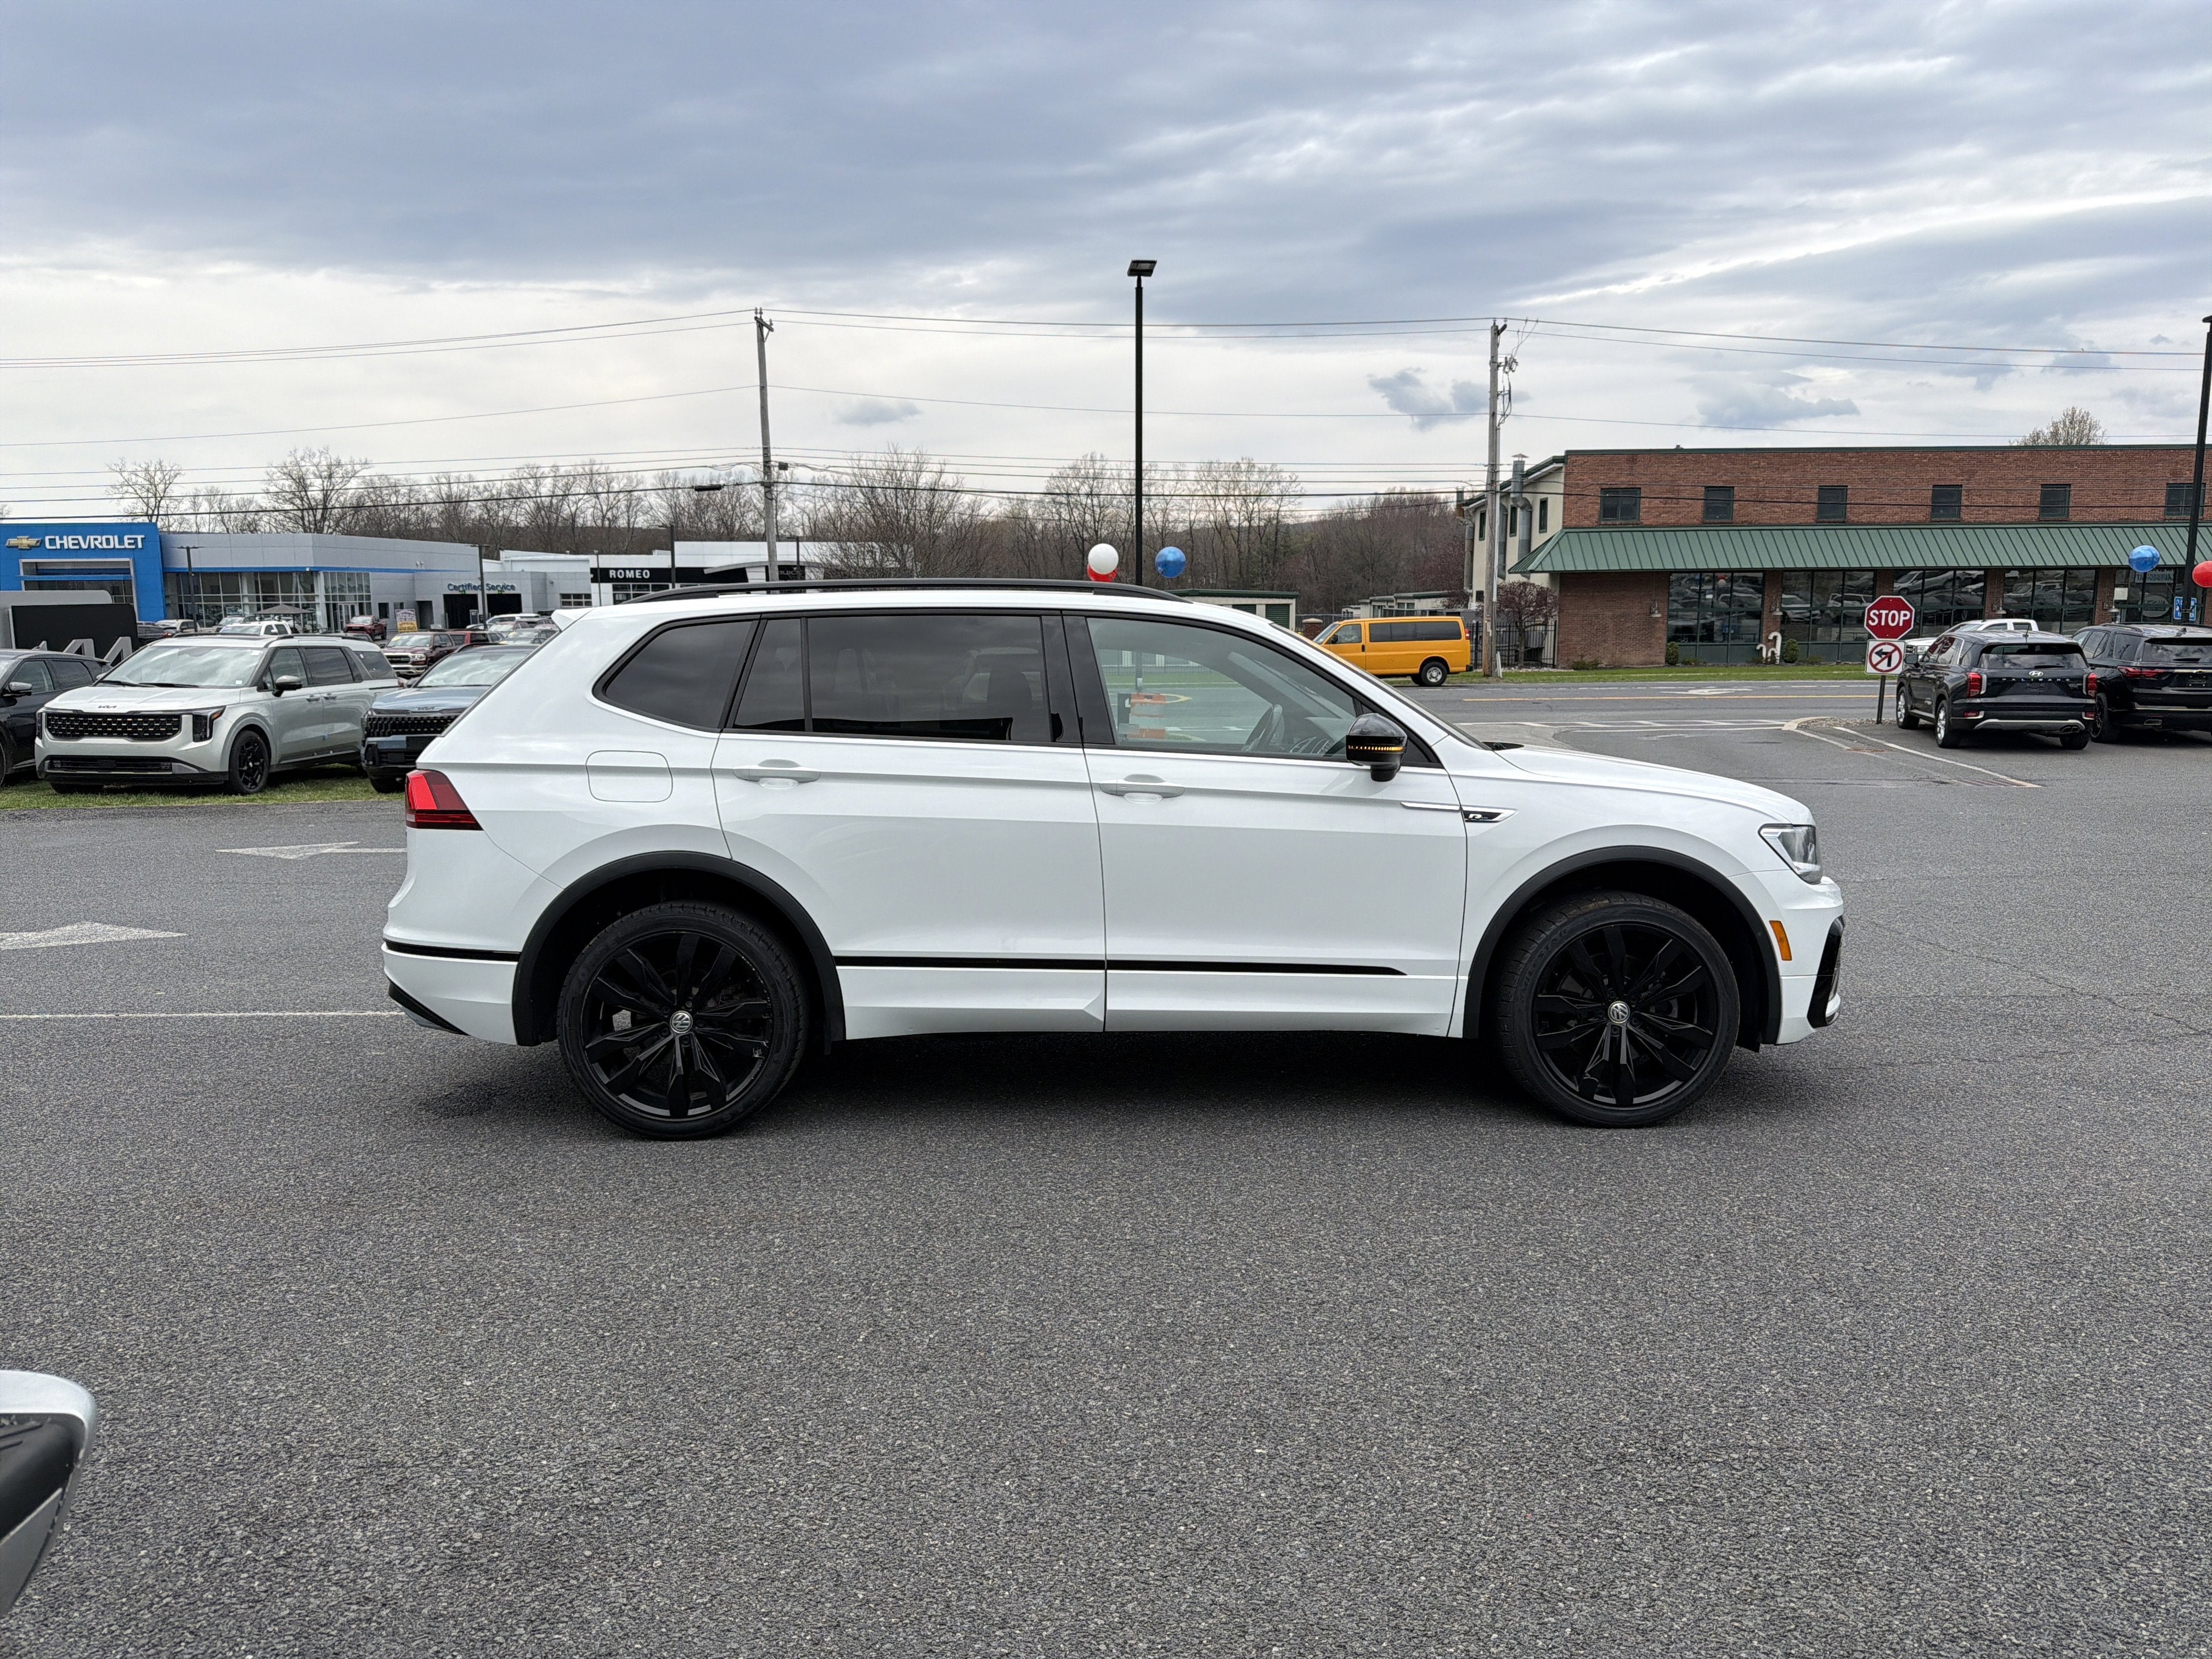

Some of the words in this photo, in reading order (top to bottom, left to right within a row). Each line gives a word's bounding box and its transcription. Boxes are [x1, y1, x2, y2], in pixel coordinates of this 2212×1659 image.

[45, 535, 145, 549] CHEVROLET
[608, 569, 651, 579] ROMEO
[447, 583, 483, 591] Certified
[486, 582, 516, 591] Service
[1868, 610, 1911, 627] STOP
